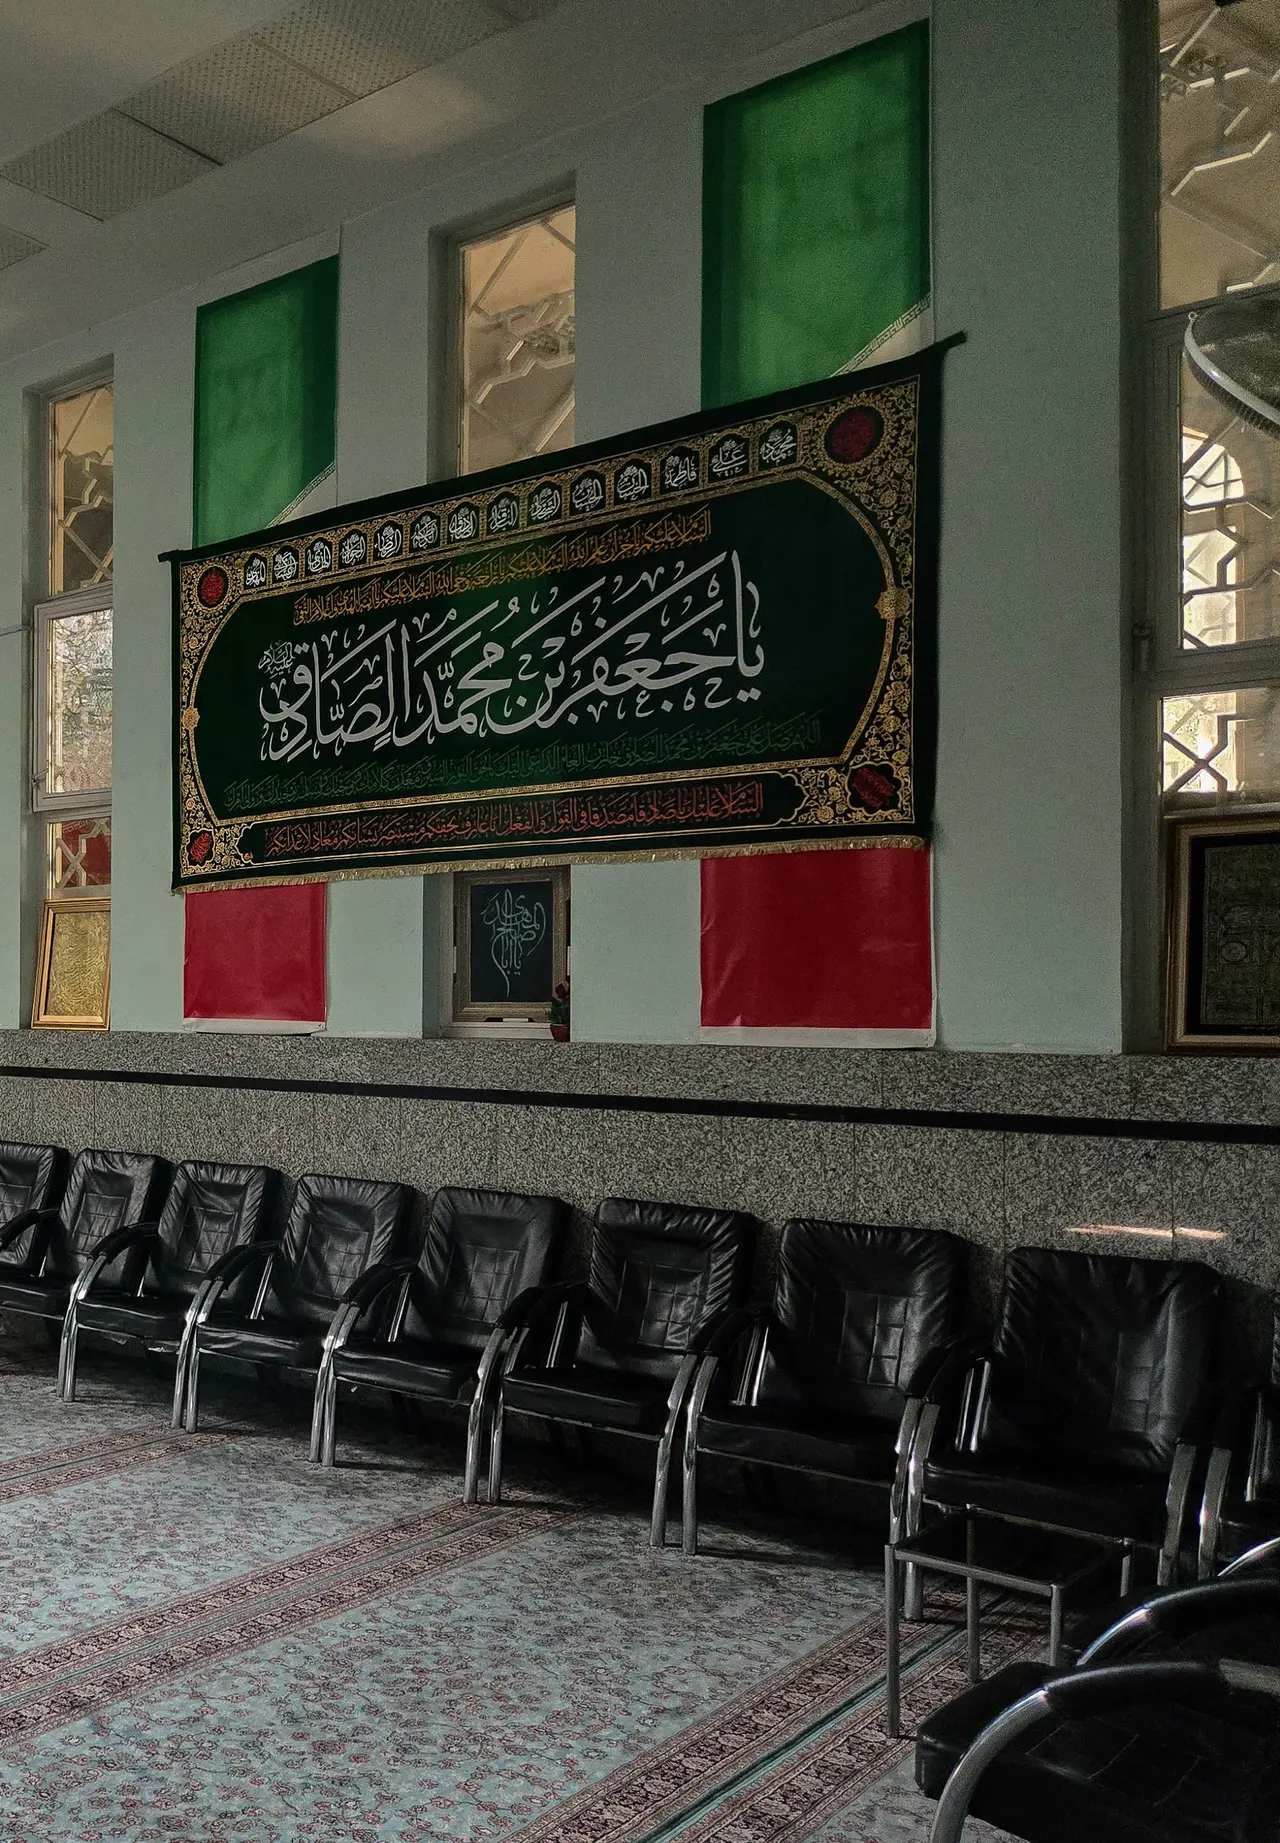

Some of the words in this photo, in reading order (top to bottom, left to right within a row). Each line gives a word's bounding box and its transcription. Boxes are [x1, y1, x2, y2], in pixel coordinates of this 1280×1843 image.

[760, 430, 796, 462] محمد
[550, 612, 736, 724] جعفر
[732, 549, 766, 701] یا
[258, 622, 411, 763] الصادق
[398, 630, 513, 748] محمد
